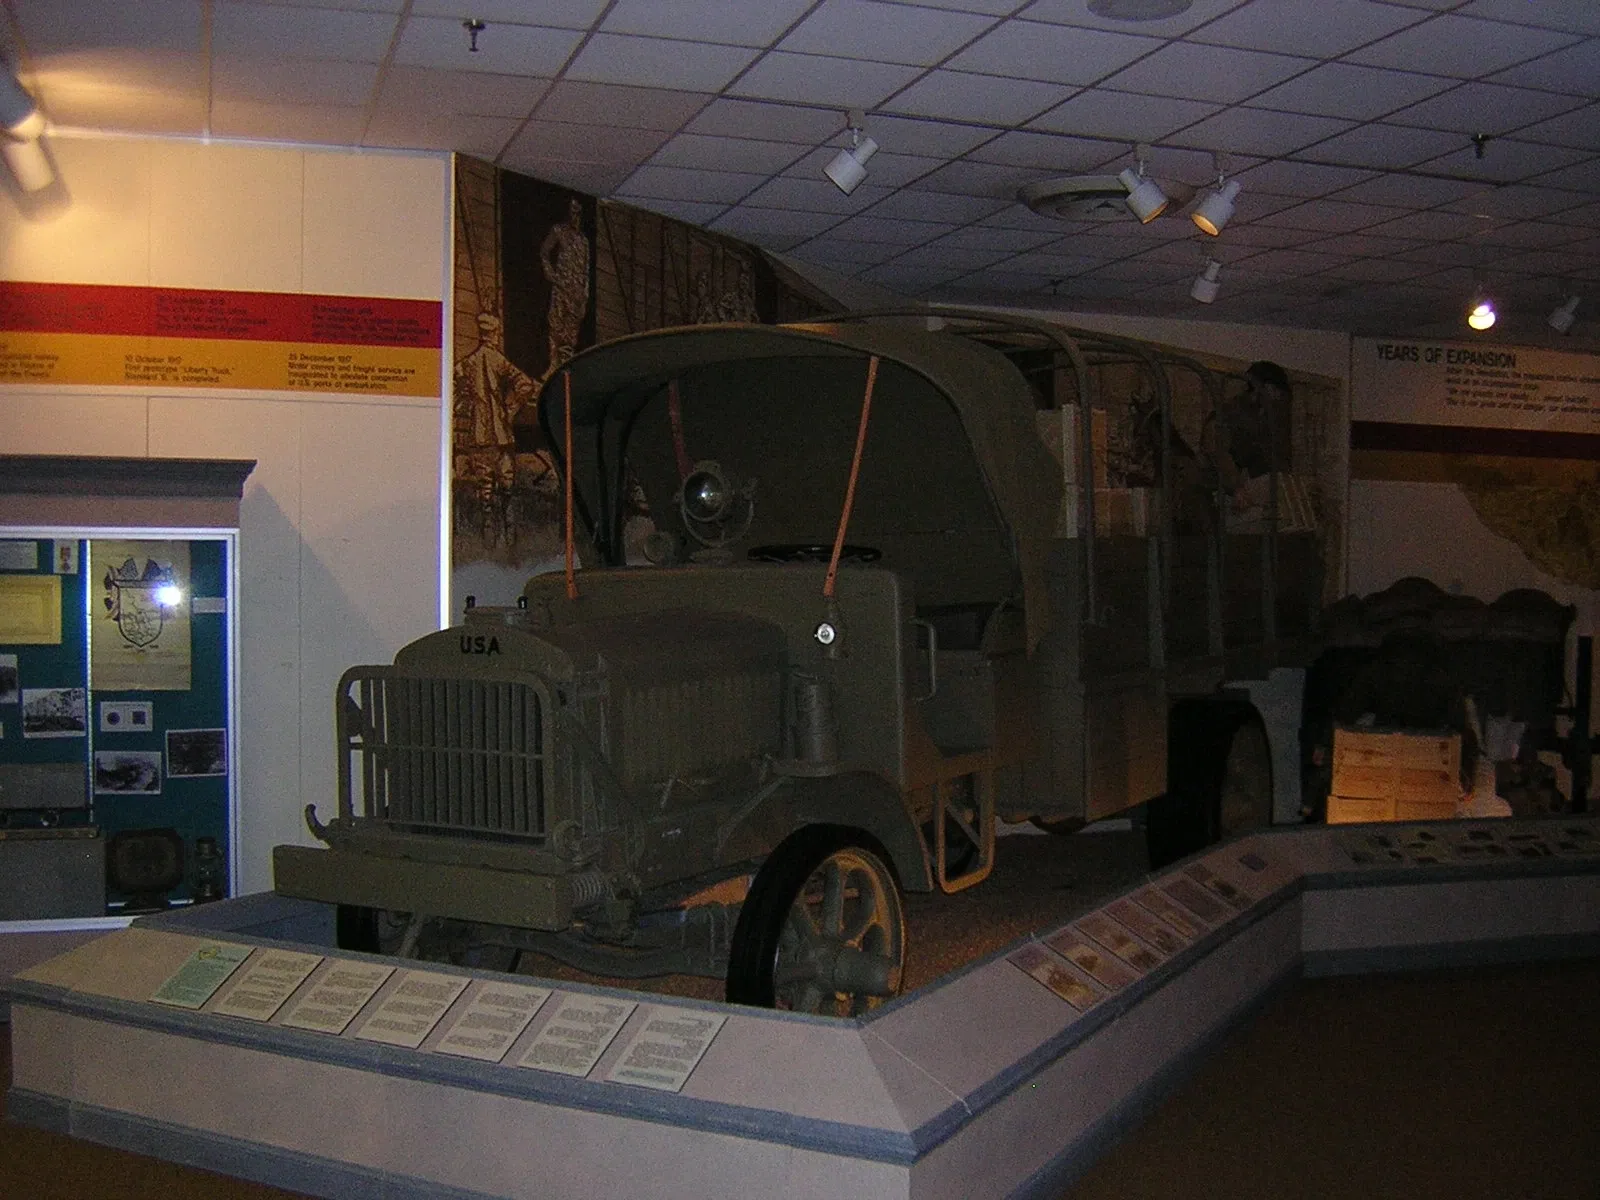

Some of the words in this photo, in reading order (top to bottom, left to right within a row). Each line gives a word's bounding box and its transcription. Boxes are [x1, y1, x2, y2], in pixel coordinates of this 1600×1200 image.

[299, 353, 335, 362] December
[1377, 344, 1419, 362] YEARS
[1424, 347, 1443, 363] OF
[1446, 348, 1516, 368] EXPANSION
[353, 365, 375, 374] freight
[370, 374, 408, 383] congestion
[313, 380, 332, 388] ports
